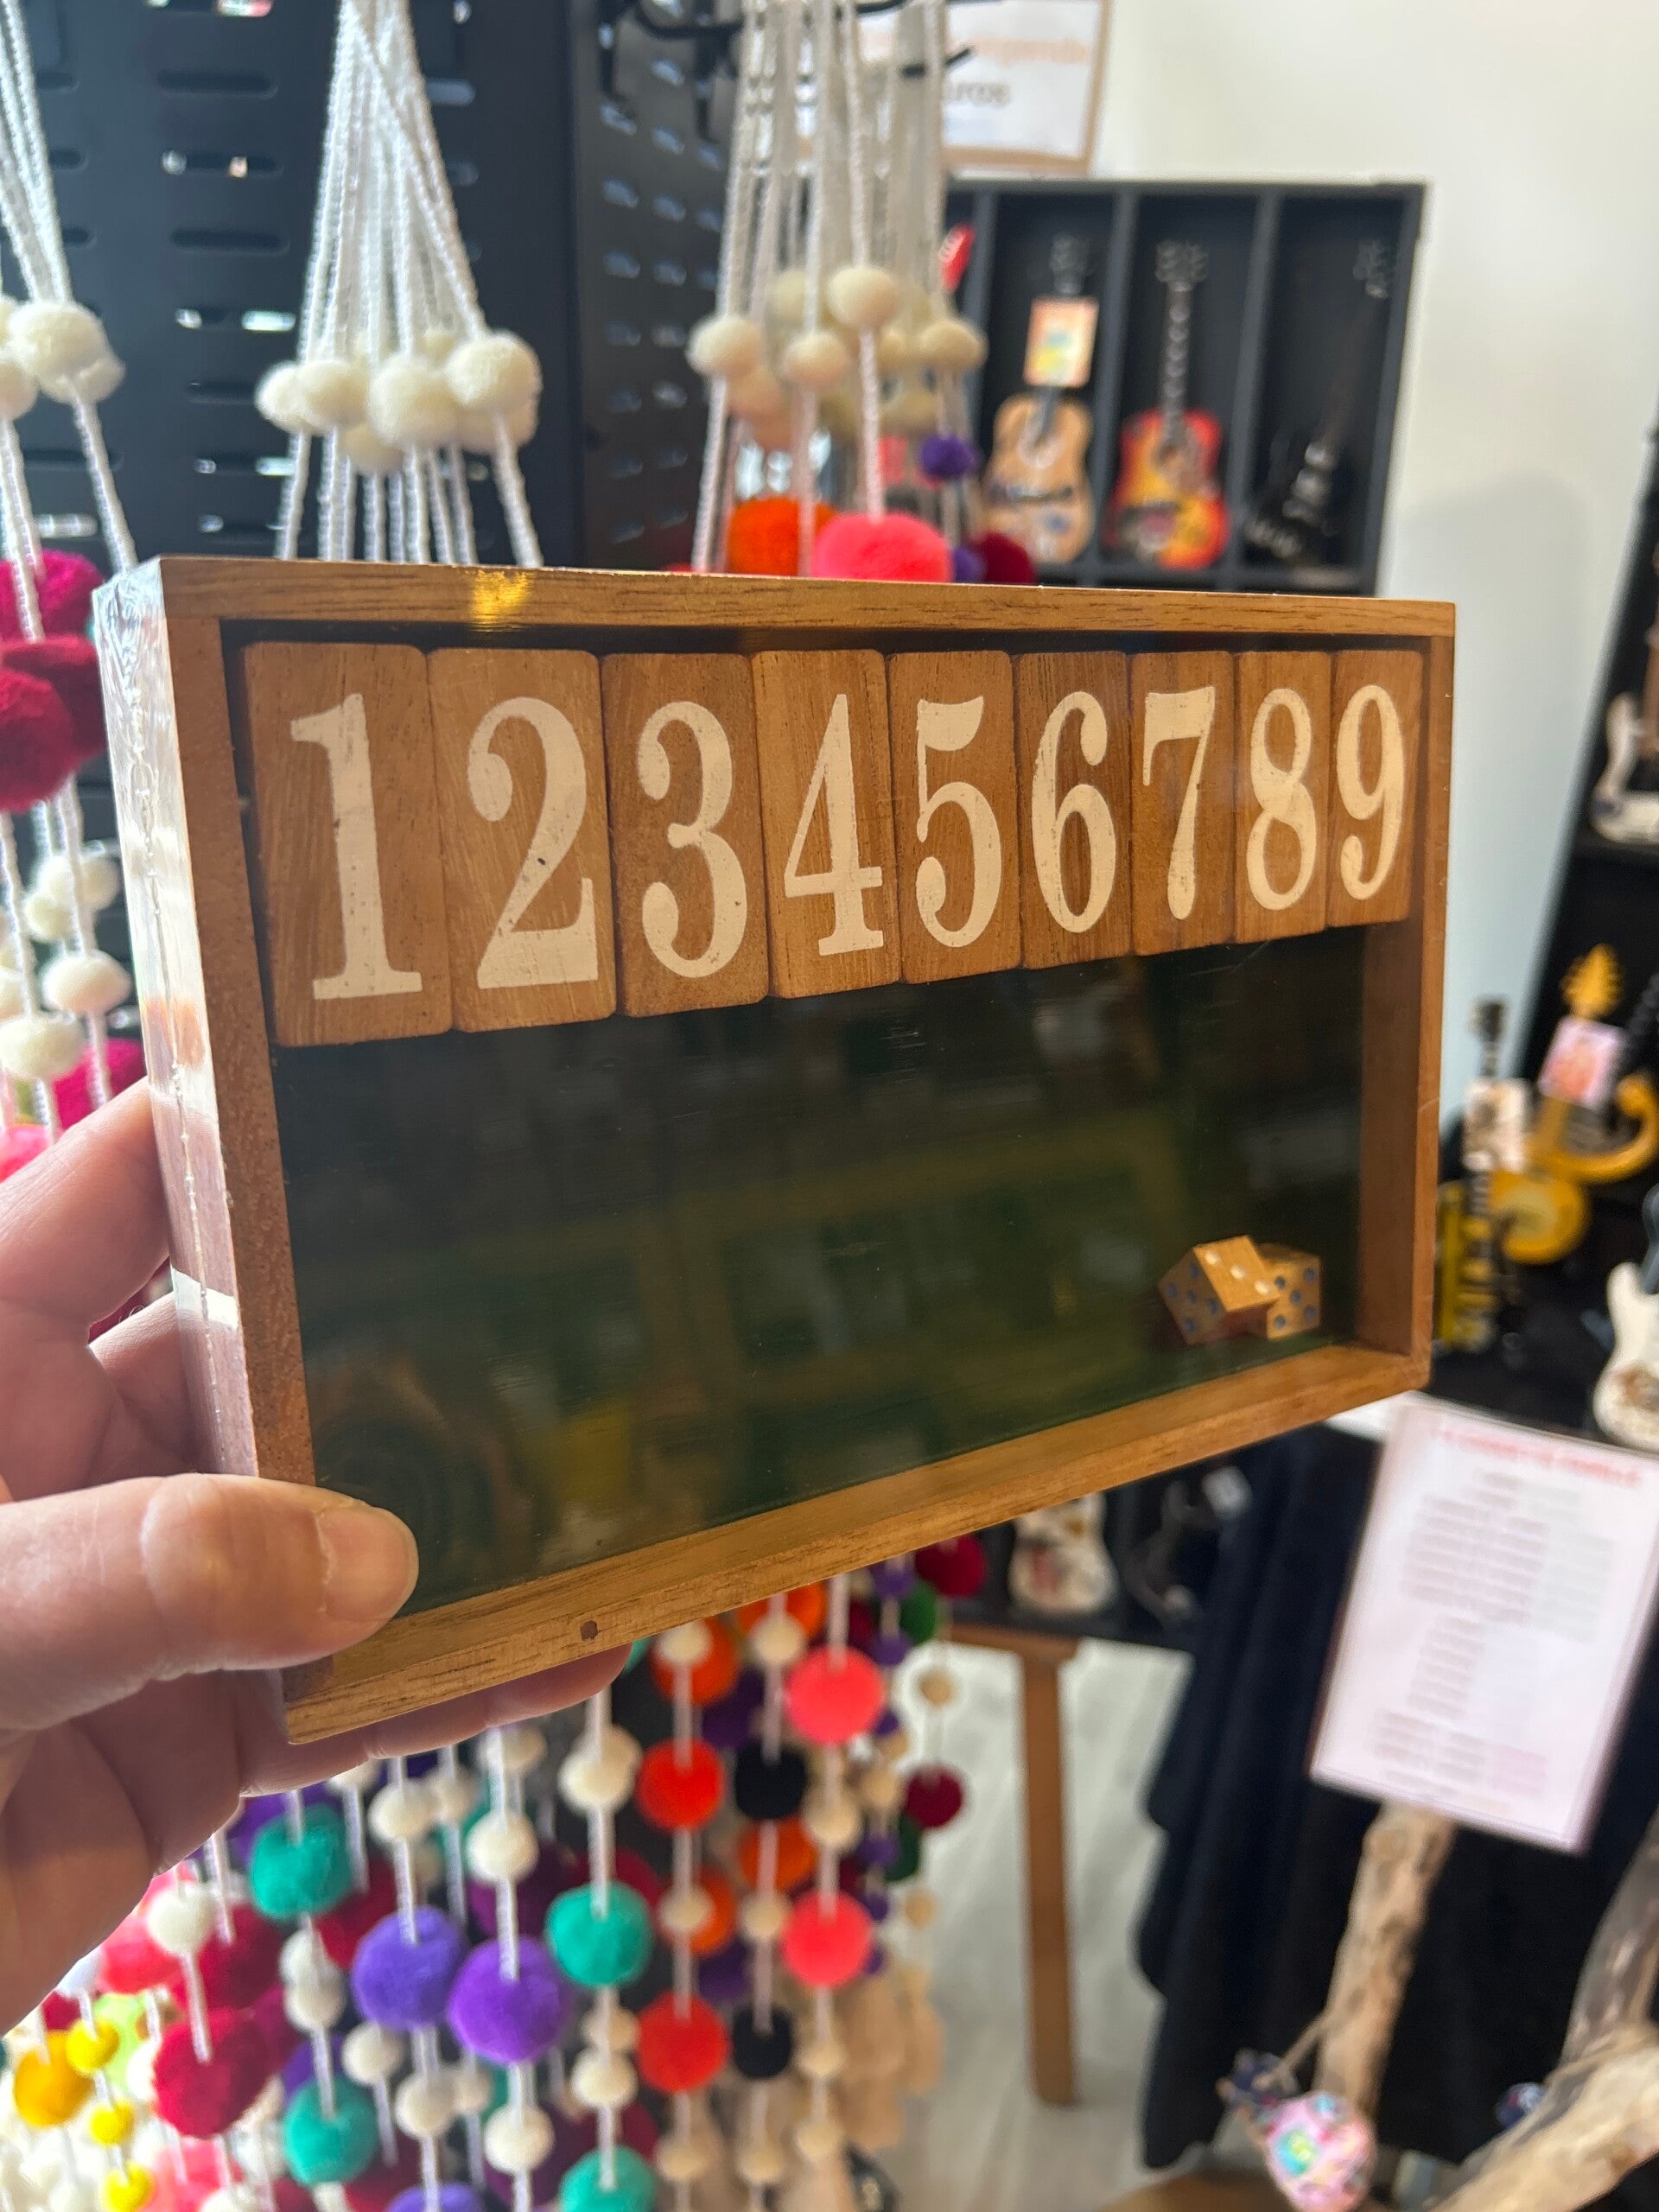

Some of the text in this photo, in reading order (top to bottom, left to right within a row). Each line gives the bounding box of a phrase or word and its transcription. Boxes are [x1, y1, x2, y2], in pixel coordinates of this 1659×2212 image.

[291, 685, 1405, 1000] 1 2 3 4 5 6 7 8 9
